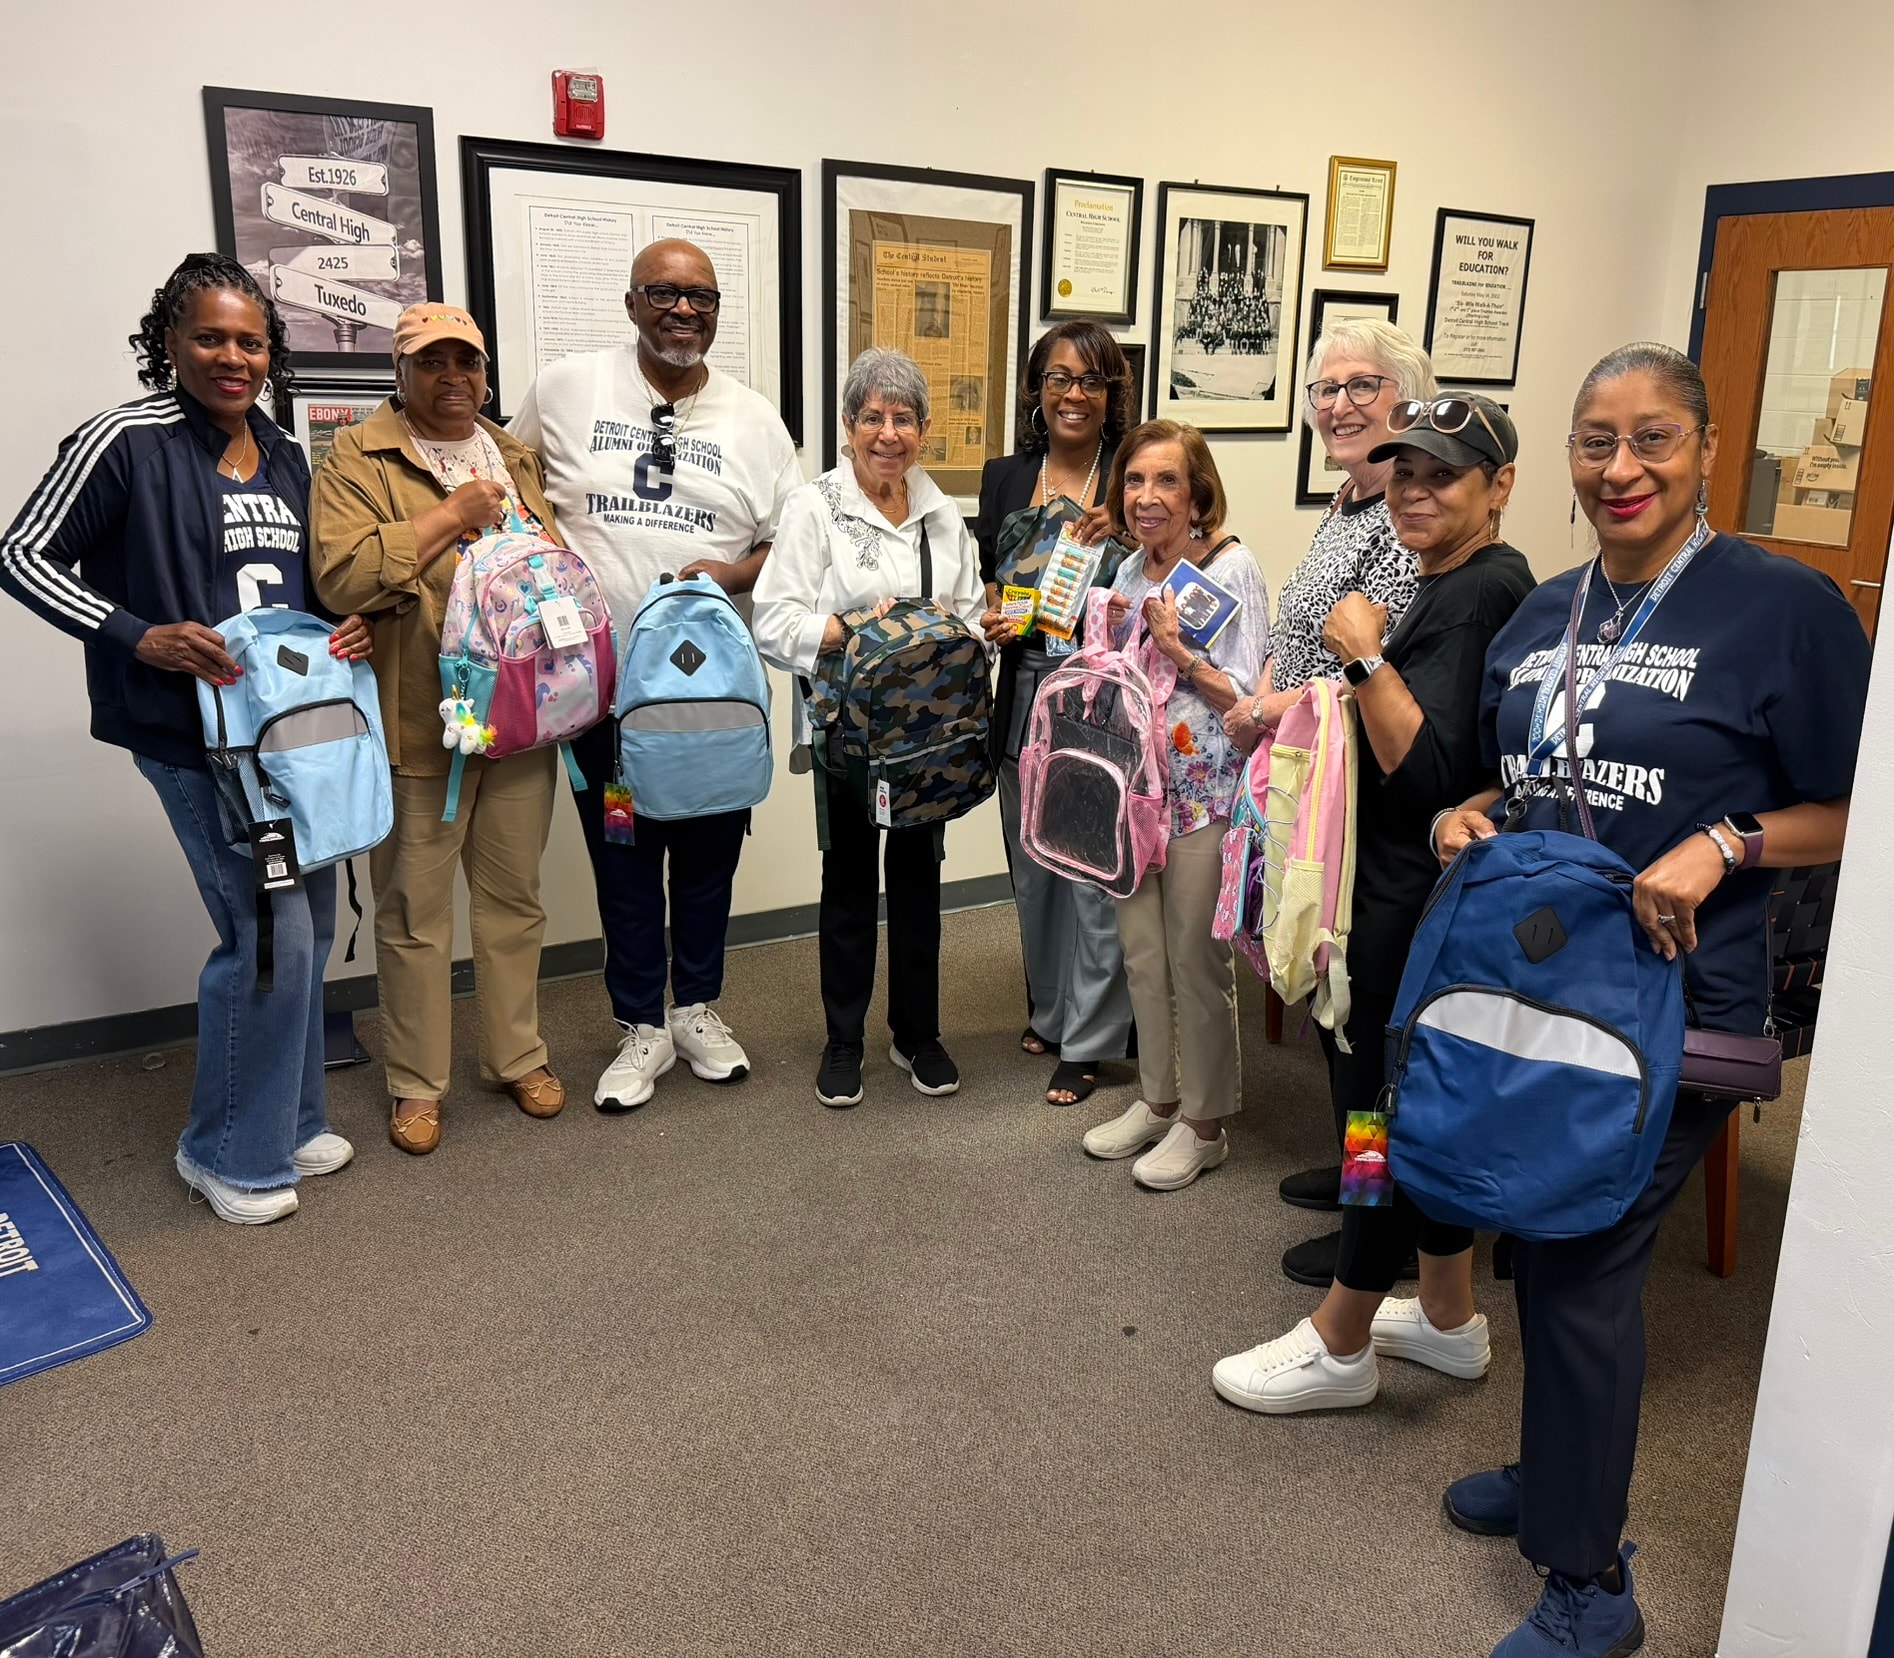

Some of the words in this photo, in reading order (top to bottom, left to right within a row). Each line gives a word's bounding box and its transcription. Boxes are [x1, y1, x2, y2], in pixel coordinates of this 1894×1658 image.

[308, 166, 357, 186] Est.1926
[1074, 200, 1113, 212] Proclamation
[291, 202, 337, 231] Central
[340, 219, 370, 244] High
[1066, 211, 1087, 219] CENTRAL
[1102, 214, 1121, 223] SCHOOL
[1455, 234, 1476, 246] WILL
[1478, 237, 1495, 247] YOU
[1496, 238, 1519, 250] WALK
[317, 256, 349, 270] 2425
[1477, 250, 1494, 261] FOR
[876, 268, 900, 276] School's
[901, 269, 919, 279] history
[920, 271, 940, 280] reflects
[941, 273, 964, 281] Detroit's
[965, 274, 983, 283] history
[1459, 262, 1509, 276] EDUCATION?
[314, 283, 367, 316] Tuxedo
[590, 435, 633, 454] ALUMNI
[594, 420, 629, 438] DETROIT
[630, 426, 658, 444] CENTR
[691, 439, 722, 459] SCHOOL
[633, 452, 674, 502] C
[222, 493, 301, 527] ENTRA
[585, 493, 716, 533] TRAILBLAZERS
[604, 513, 635, 526] MAKING
[637, 517, 644, 526] A
[645, 519, 695, 534] DIFFERENCE
[255, 526, 300, 554] SCHOOL
[1650, 572, 1674, 603] DETROIT
[1670, 545, 1696, 573] CENTRAL
[1645, 643, 1701, 669] SCHOOL
